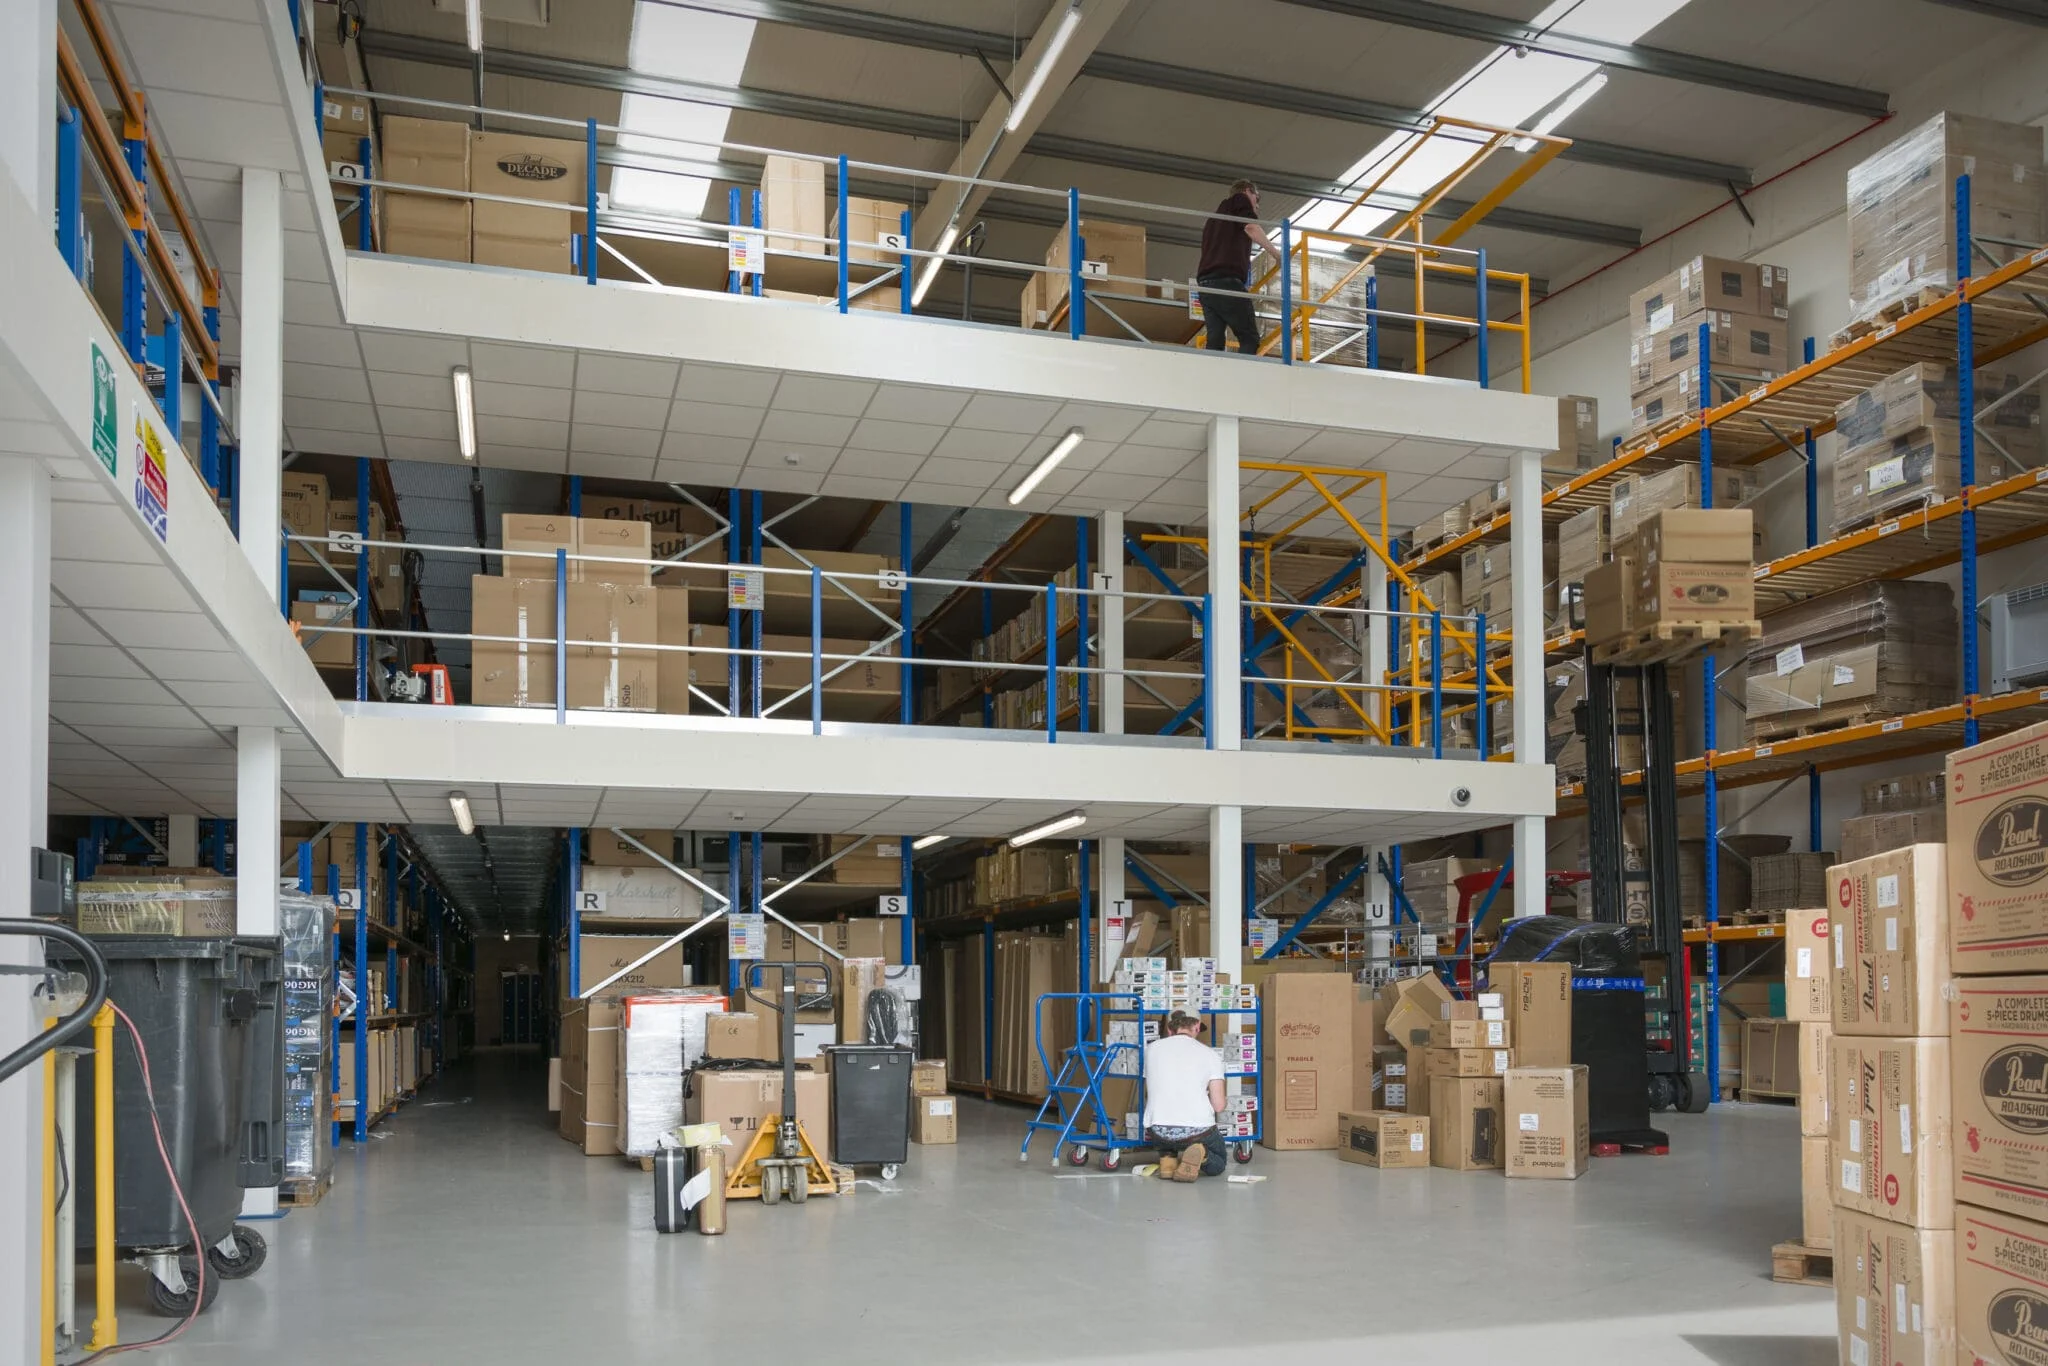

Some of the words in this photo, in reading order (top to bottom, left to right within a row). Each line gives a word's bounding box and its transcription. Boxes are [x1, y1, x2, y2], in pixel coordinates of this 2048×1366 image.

[507, 163, 558, 177] DECADE
[886, 236, 899, 248] S
[1088, 263, 1100, 273] T
[282, 491, 304, 499] aney
[334, 512, 358, 520] Lane
[338, 533, 355, 551] Q
[1101, 575, 1113, 590] T
[621, 684, 631, 707] KSub
[1990, 760, 1995, 771] A
[1997, 744, 2040, 768] COMPLETE
[1980, 766, 2009, 785] 5-PIECE
[1992, 809, 2041, 856] Pearl
[1994, 851, 2046, 872] ROADSHOW
[340, 890, 354, 907] Q
[583, 893, 599, 909] R
[887, 897, 900, 913] S
[1113, 901, 1125, 916] T
[1372, 904, 1384, 918] U
[284, 981, 317, 989] MG06
[1862, 959, 1874, 1012] Pearl
[1996, 998, 2002, 1008] A
[2004, 998, 2048, 1010] COMPLETE
[1987, 1010, 2018, 1021] 5-PIECE
[285, 1028, 317, 1036] MG06
[1999, 1056, 2048, 1096] Pearl
[1863, 1060, 1876, 1115] Pearl
[2004, 1237, 2011, 1249] A
[1994, 1246, 2027, 1266] 5-PIECE
[1870, 1240, 1882, 1297] Pearl
